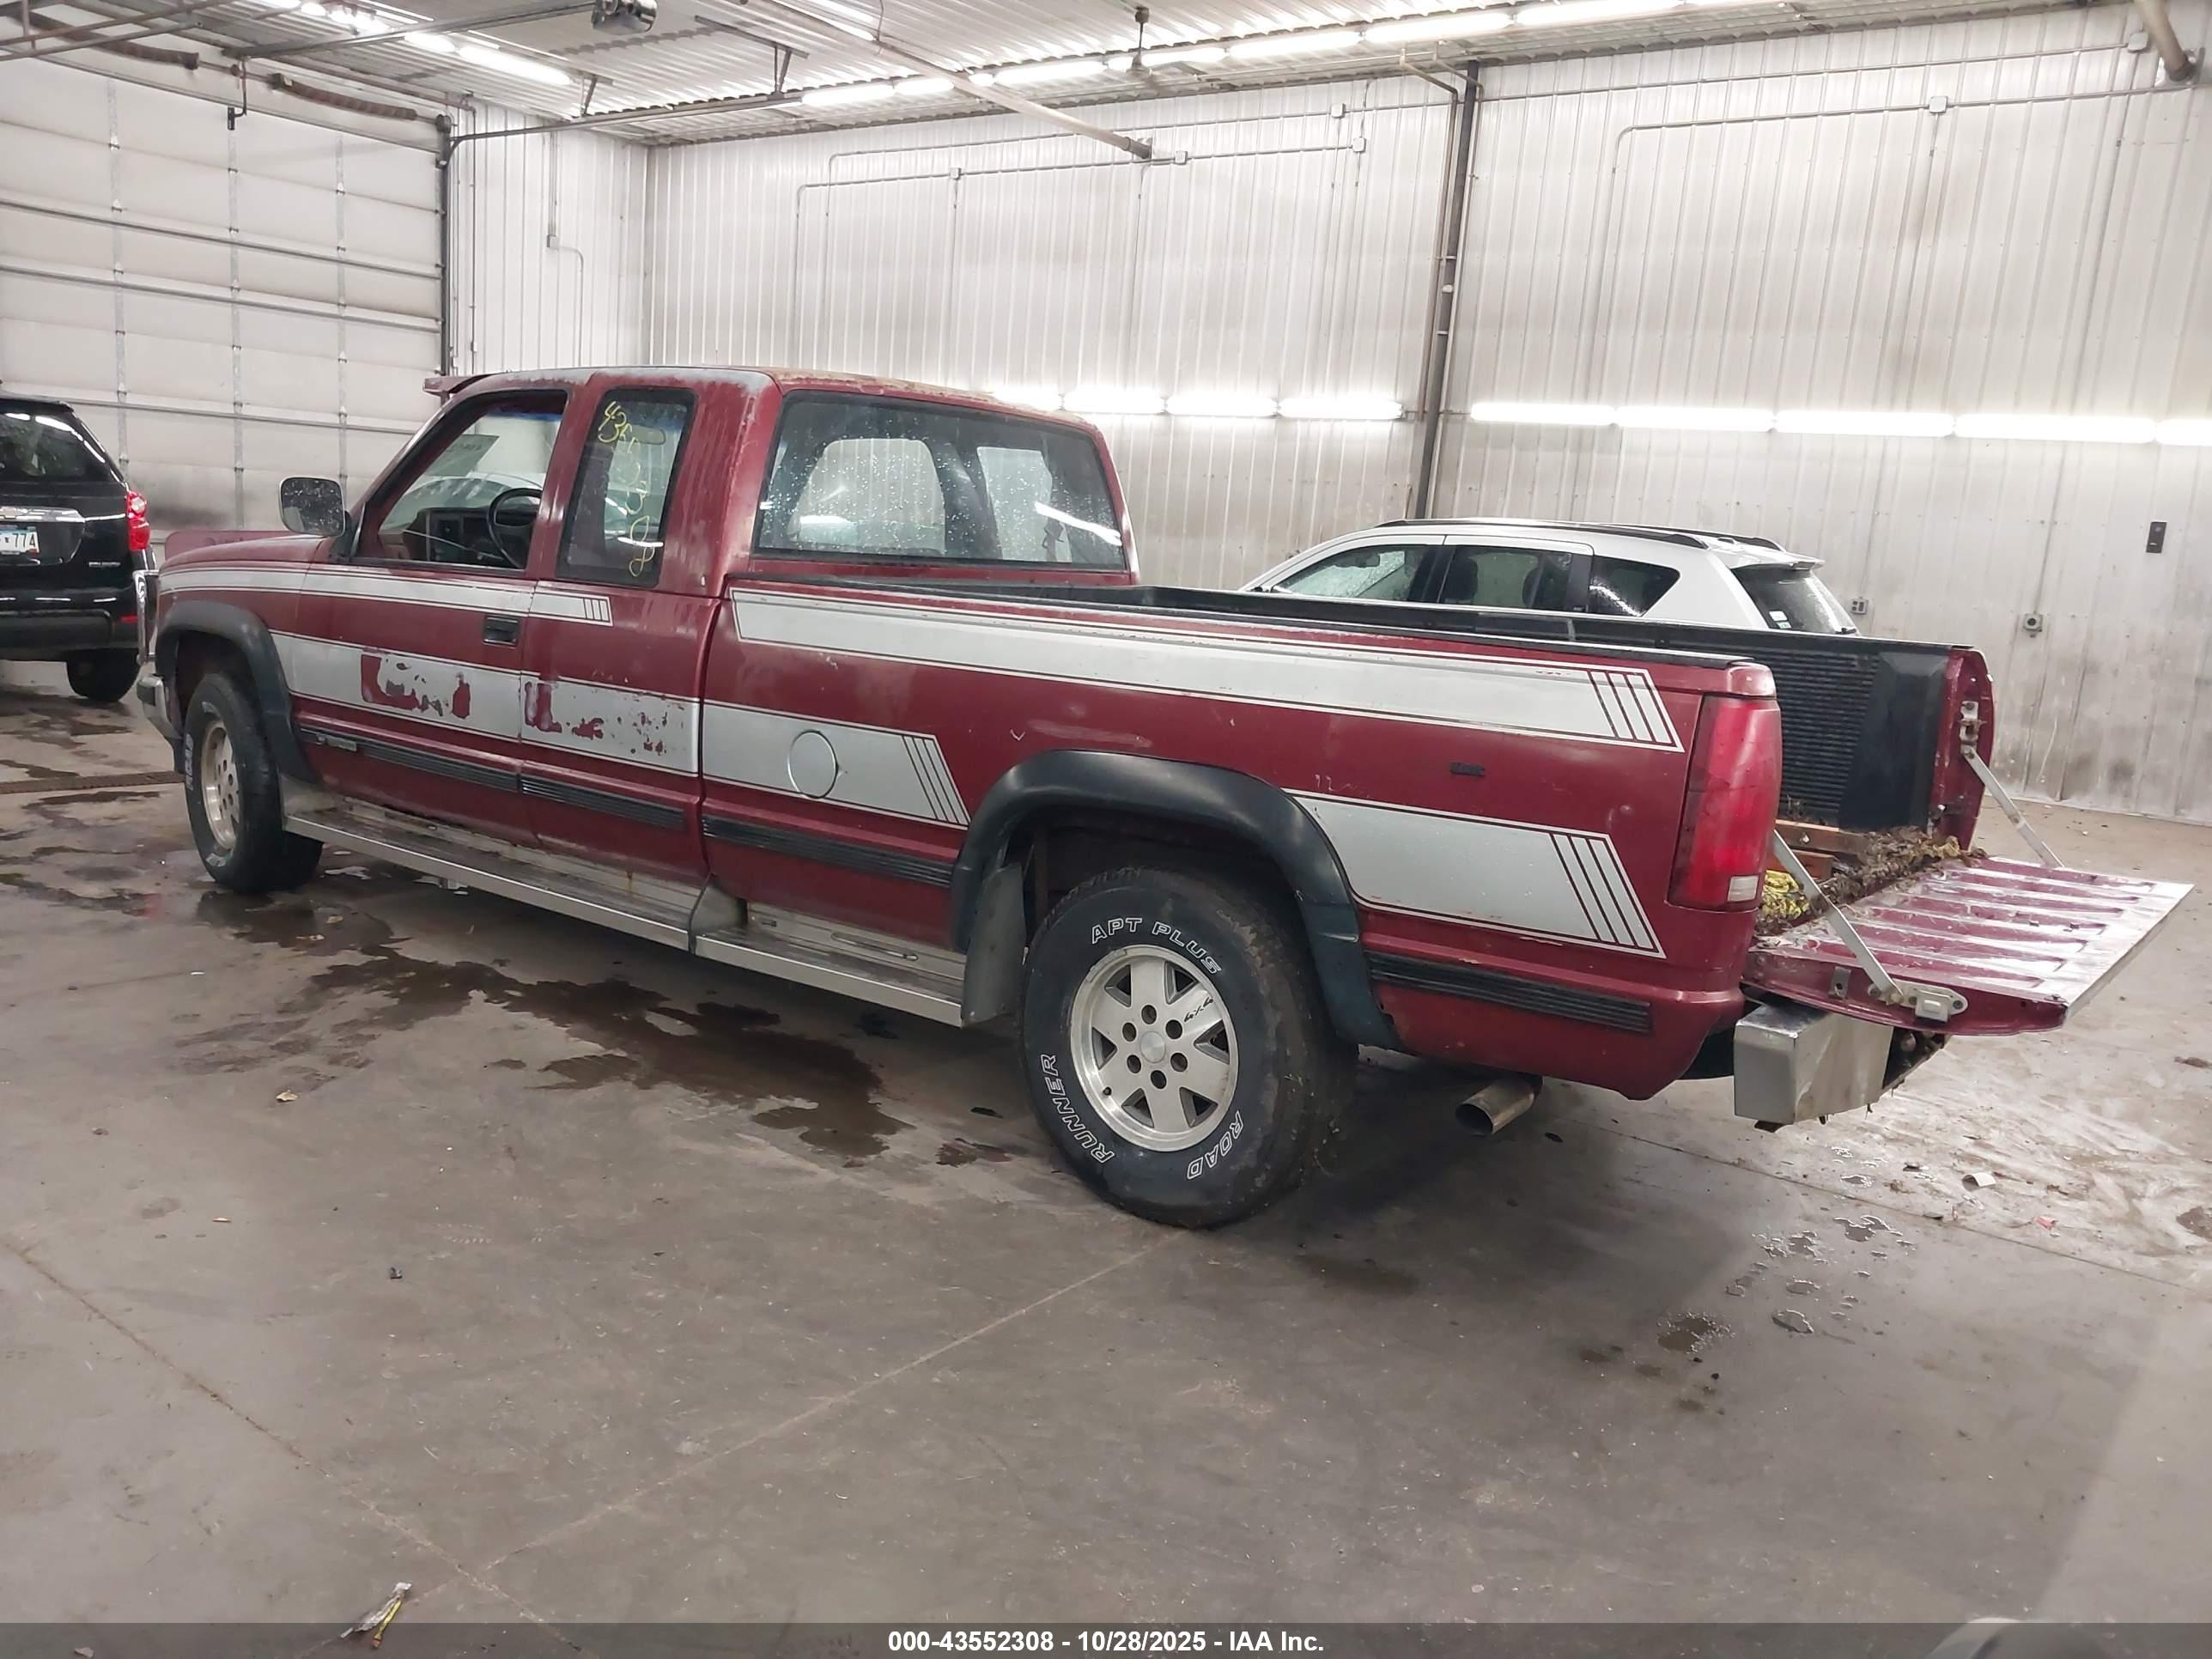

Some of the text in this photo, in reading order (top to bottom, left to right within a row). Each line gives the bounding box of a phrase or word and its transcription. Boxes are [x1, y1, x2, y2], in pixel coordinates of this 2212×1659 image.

[1091, 916, 1222, 975] APT PLUS
[1040, 1053, 1244, 1181] ROAD RUNNER
